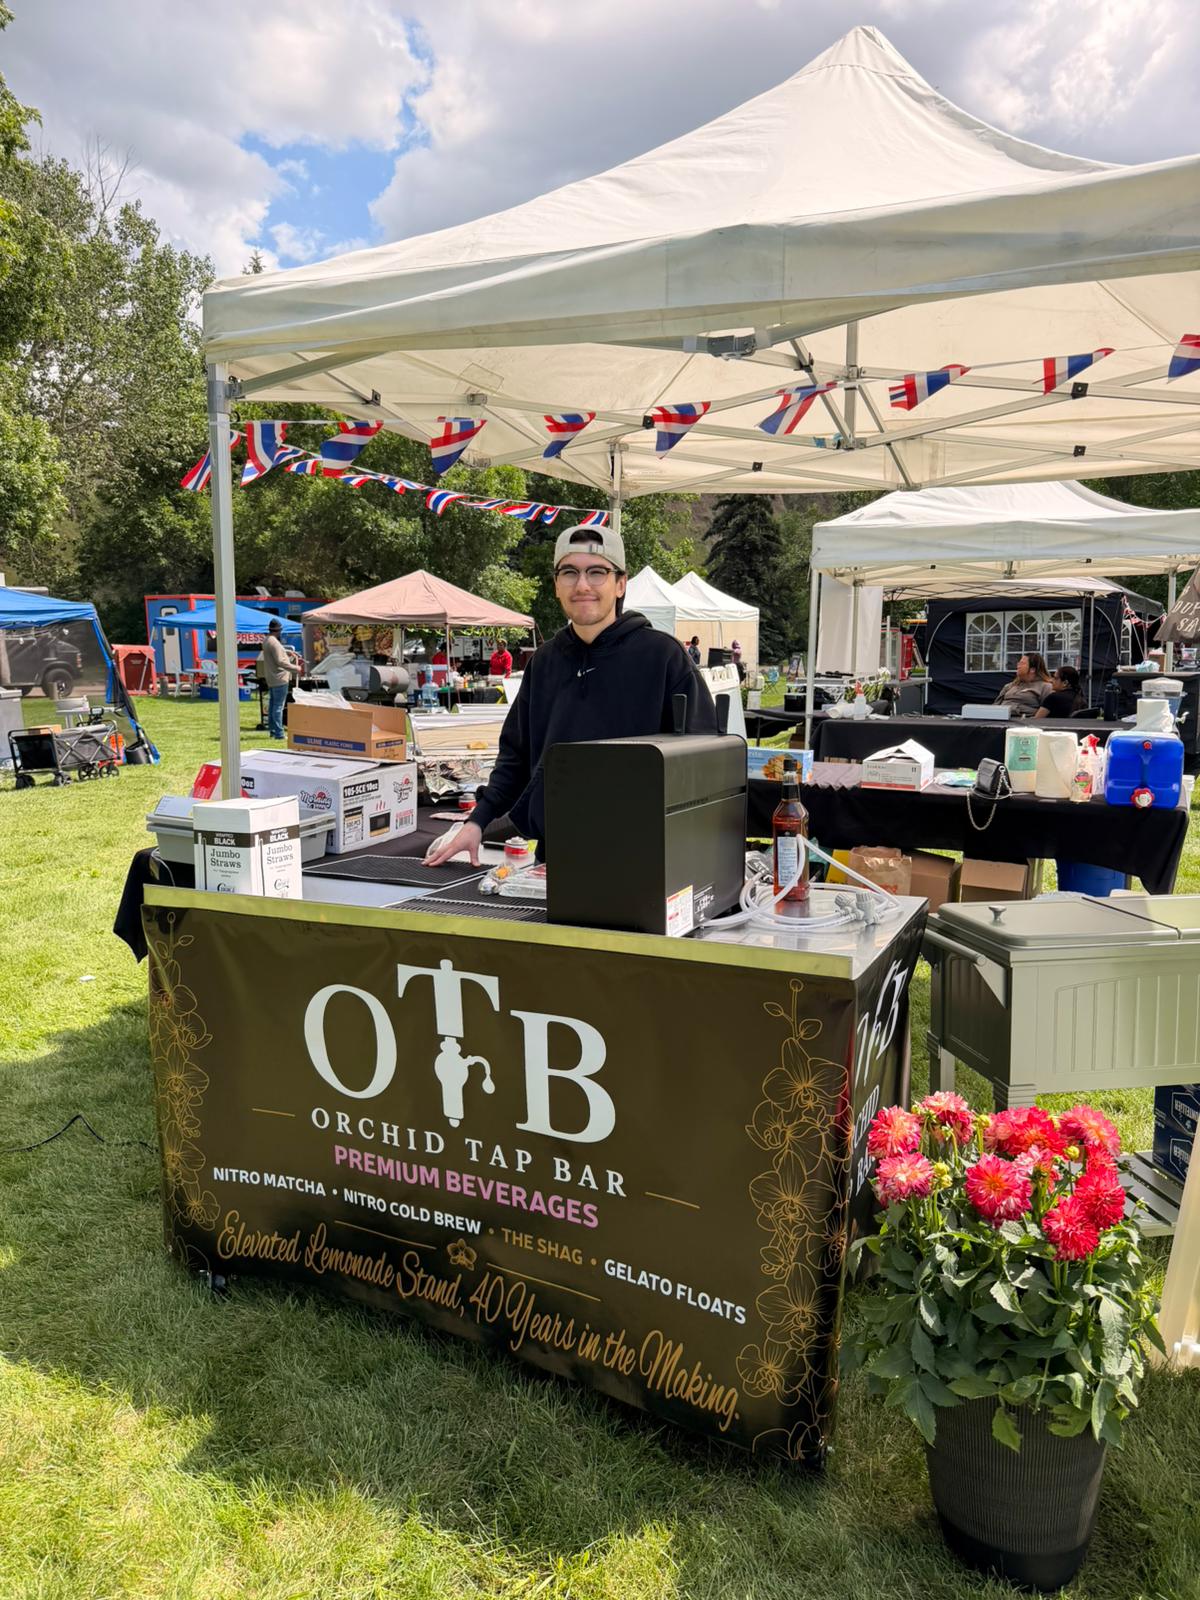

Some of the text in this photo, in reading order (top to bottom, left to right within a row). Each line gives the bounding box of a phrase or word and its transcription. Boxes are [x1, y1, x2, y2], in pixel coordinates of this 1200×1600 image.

[214, 837, 236, 846] BLACK
[270, 831, 289, 843] BLACK
[210, 848, 241, 859] Jumbo
[266, 844, 293, 856] Jumbo
[210, 858, 242, 868] Straws
[266, 853, 294, 865] Straws
[311, 1107, 627, 1197] ORCHID TAP BAR
[334, 1144, 599, 1228] PREMIUM BEVERAGES
[213, 1166, 747, 1325] NITRO MATCHA NITRO COLD BREW THE SHAG GELATO FLOATS
[217, 1209, 741, 1432] Elevated Lemonade Stand, 40 Years in the Making.
